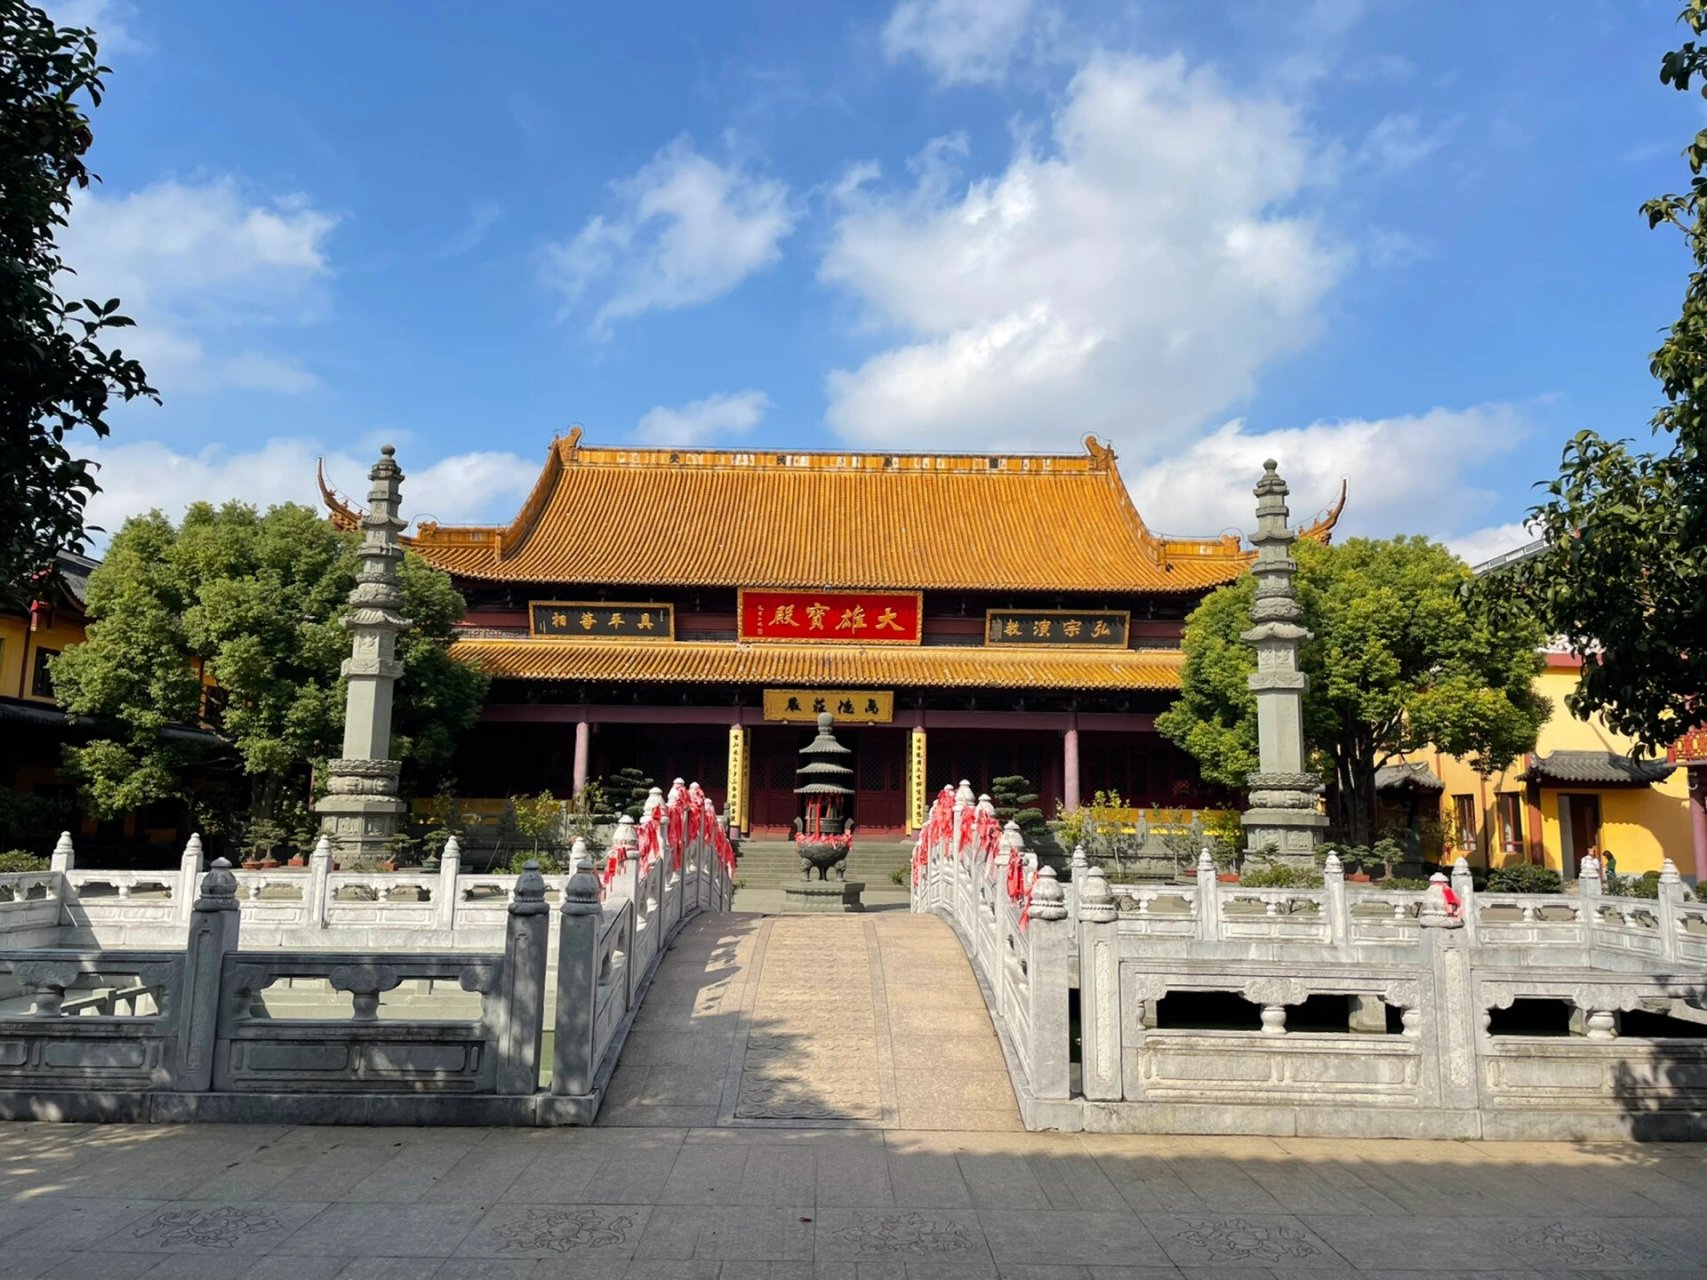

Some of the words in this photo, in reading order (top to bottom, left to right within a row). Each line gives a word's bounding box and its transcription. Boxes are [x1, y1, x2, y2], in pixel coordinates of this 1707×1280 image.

[768, 602, 905, 634] 大雄寶殿
[1003, 619, 1111, 637] 弘宗演教
